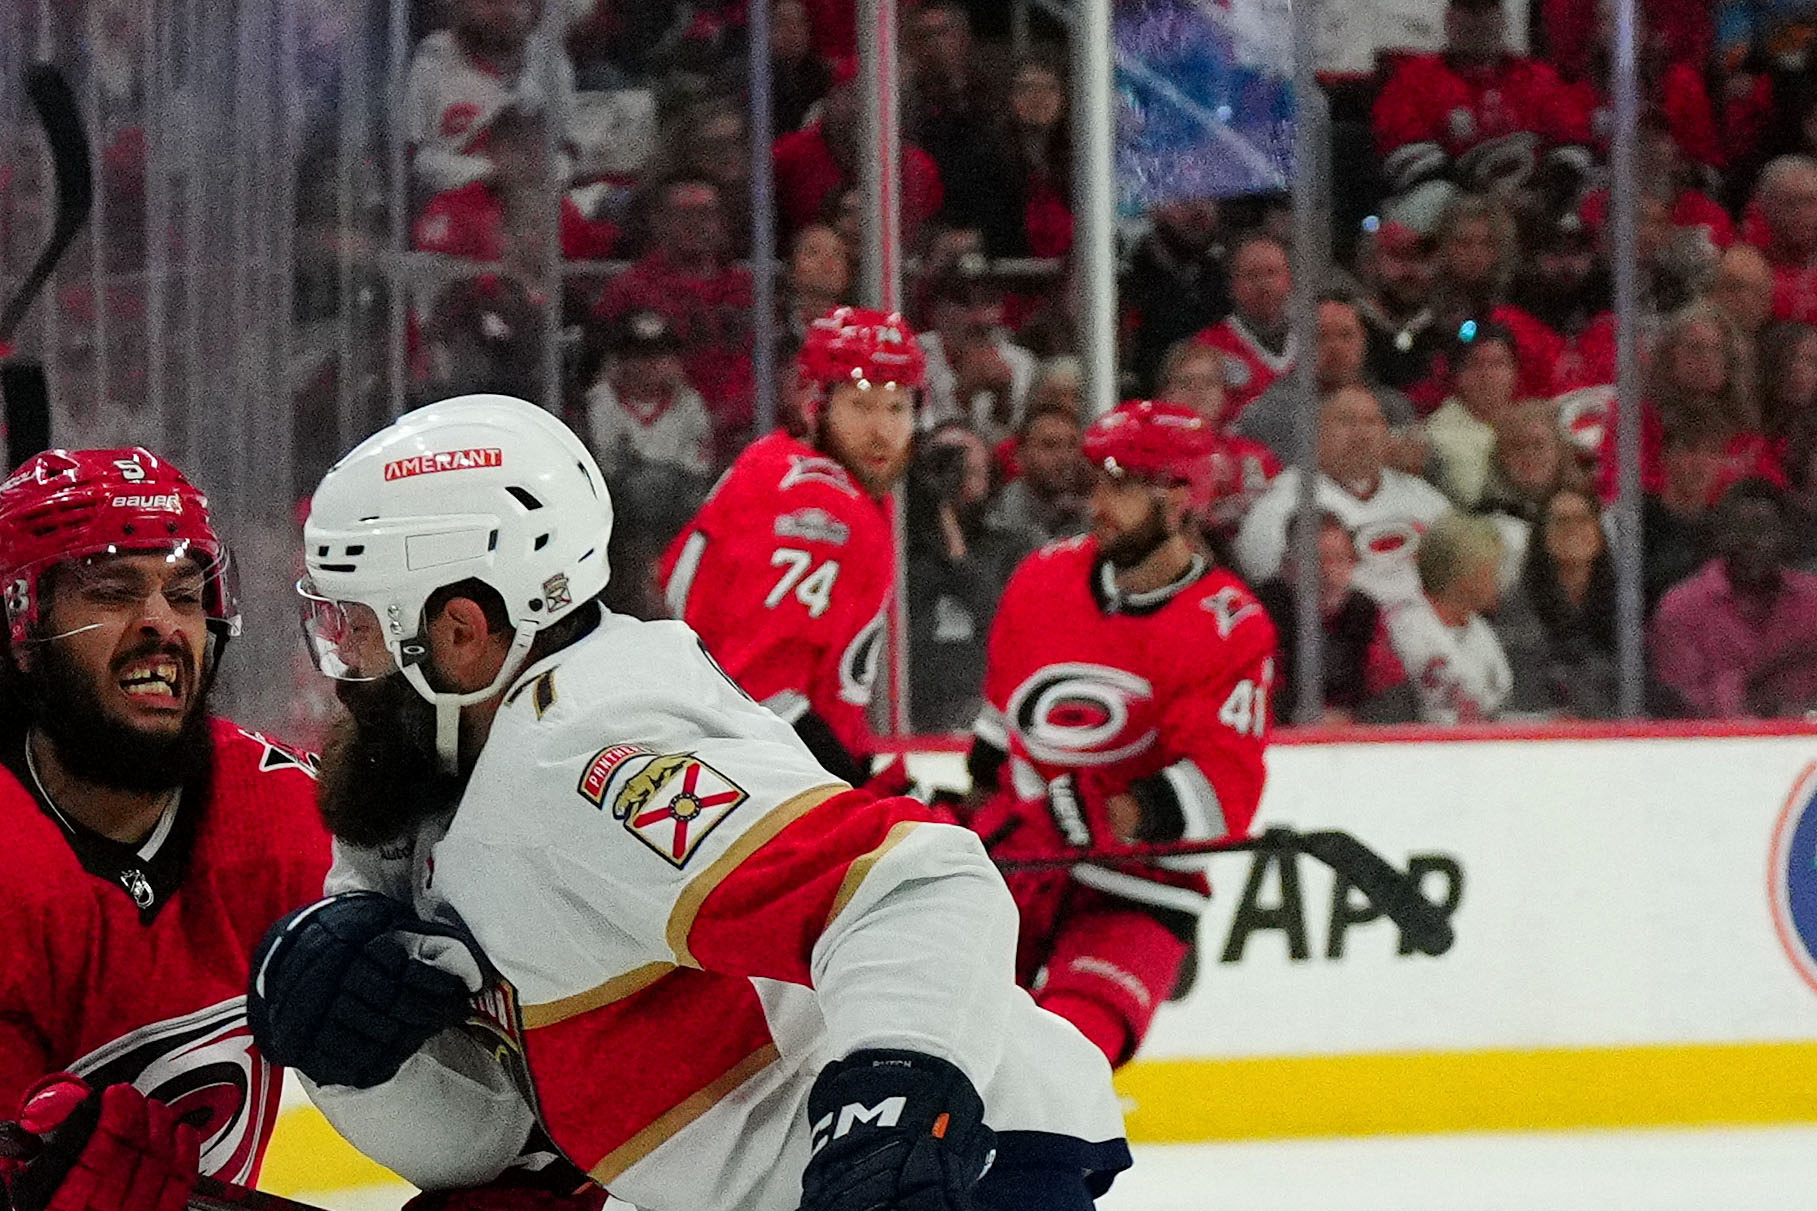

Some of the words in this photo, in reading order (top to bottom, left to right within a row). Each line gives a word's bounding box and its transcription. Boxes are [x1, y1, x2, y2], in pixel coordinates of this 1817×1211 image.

[112, 459, 146, 481] 5
[386, 448, 501, 481] AMERANT
[763, 546, 841, 619] 74
